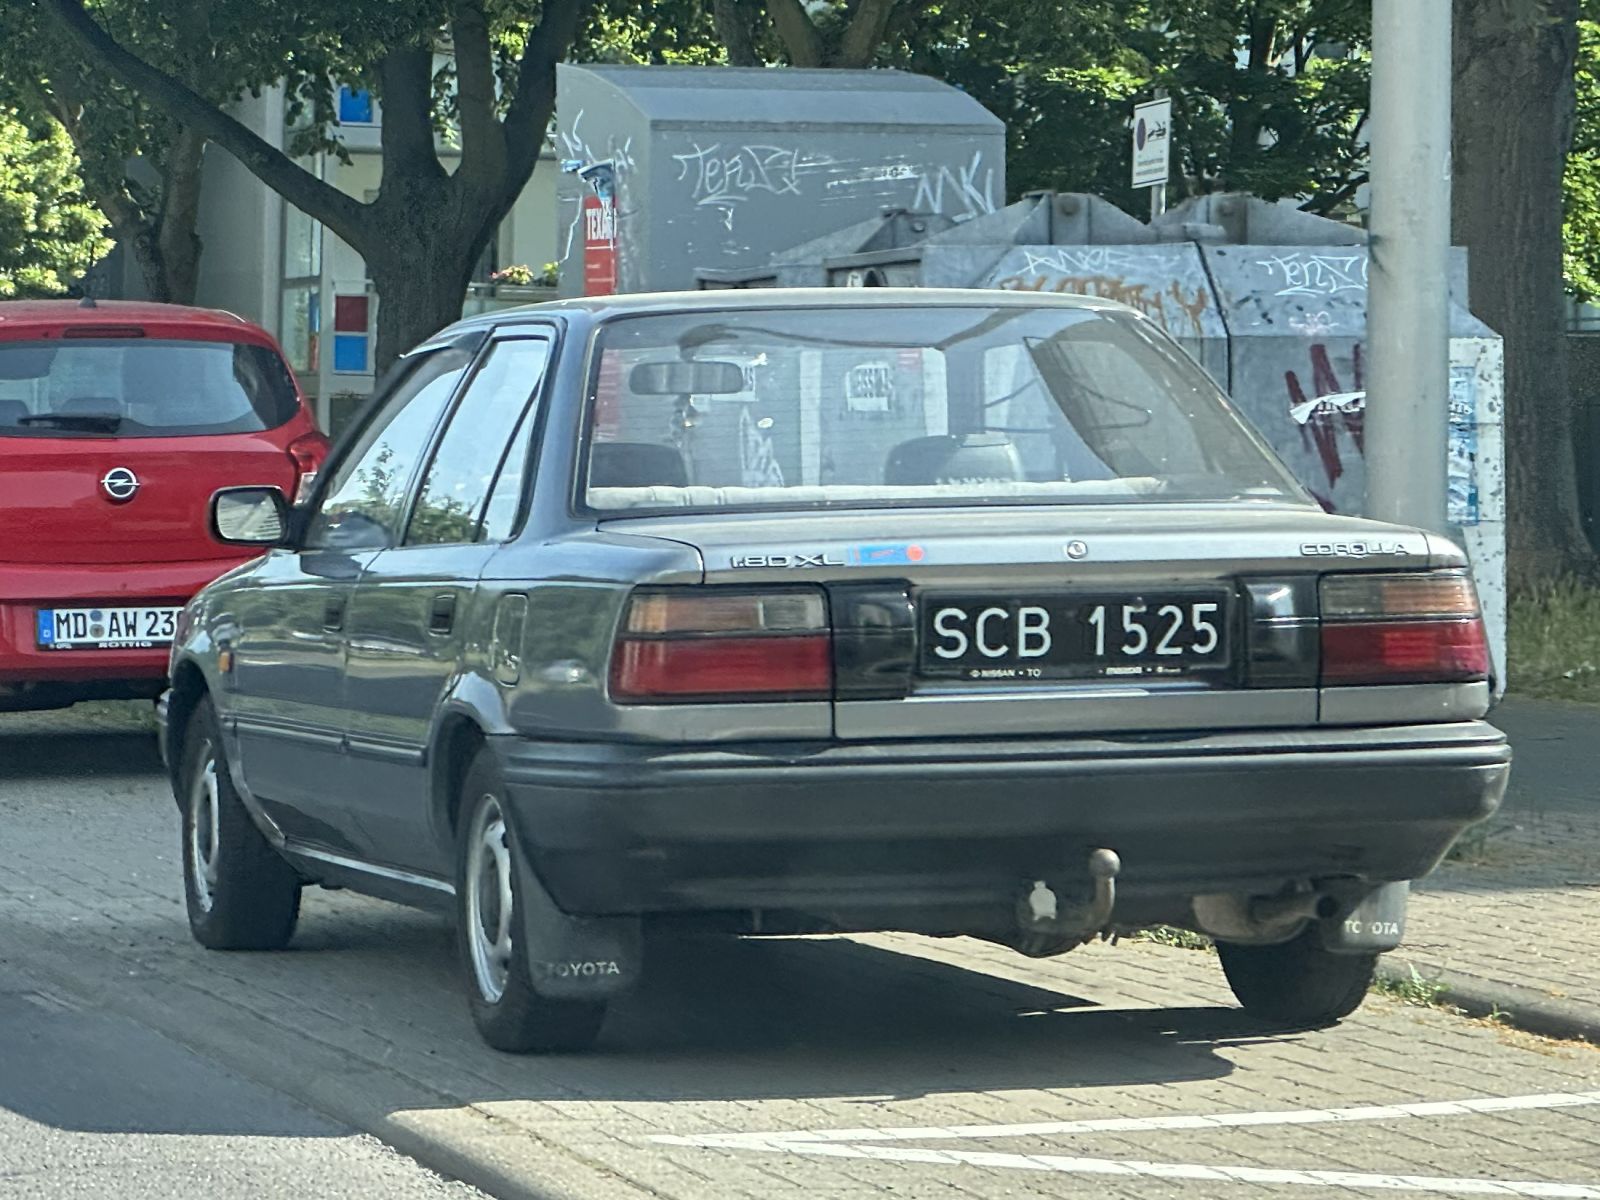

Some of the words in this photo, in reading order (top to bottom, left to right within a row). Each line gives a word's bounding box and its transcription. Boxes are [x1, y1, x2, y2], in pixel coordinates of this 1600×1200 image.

[795, 552, 845, 567] XL
[1300, 542, 1410, 557] COROLLA
[56, 612, 87, 639] MD
[108, 611, 137, 638] AW
[145, 610, 180, 637] 23
[933, 606, 1052, 659] SCB
[1088, 602, 1219, 657] 1525
